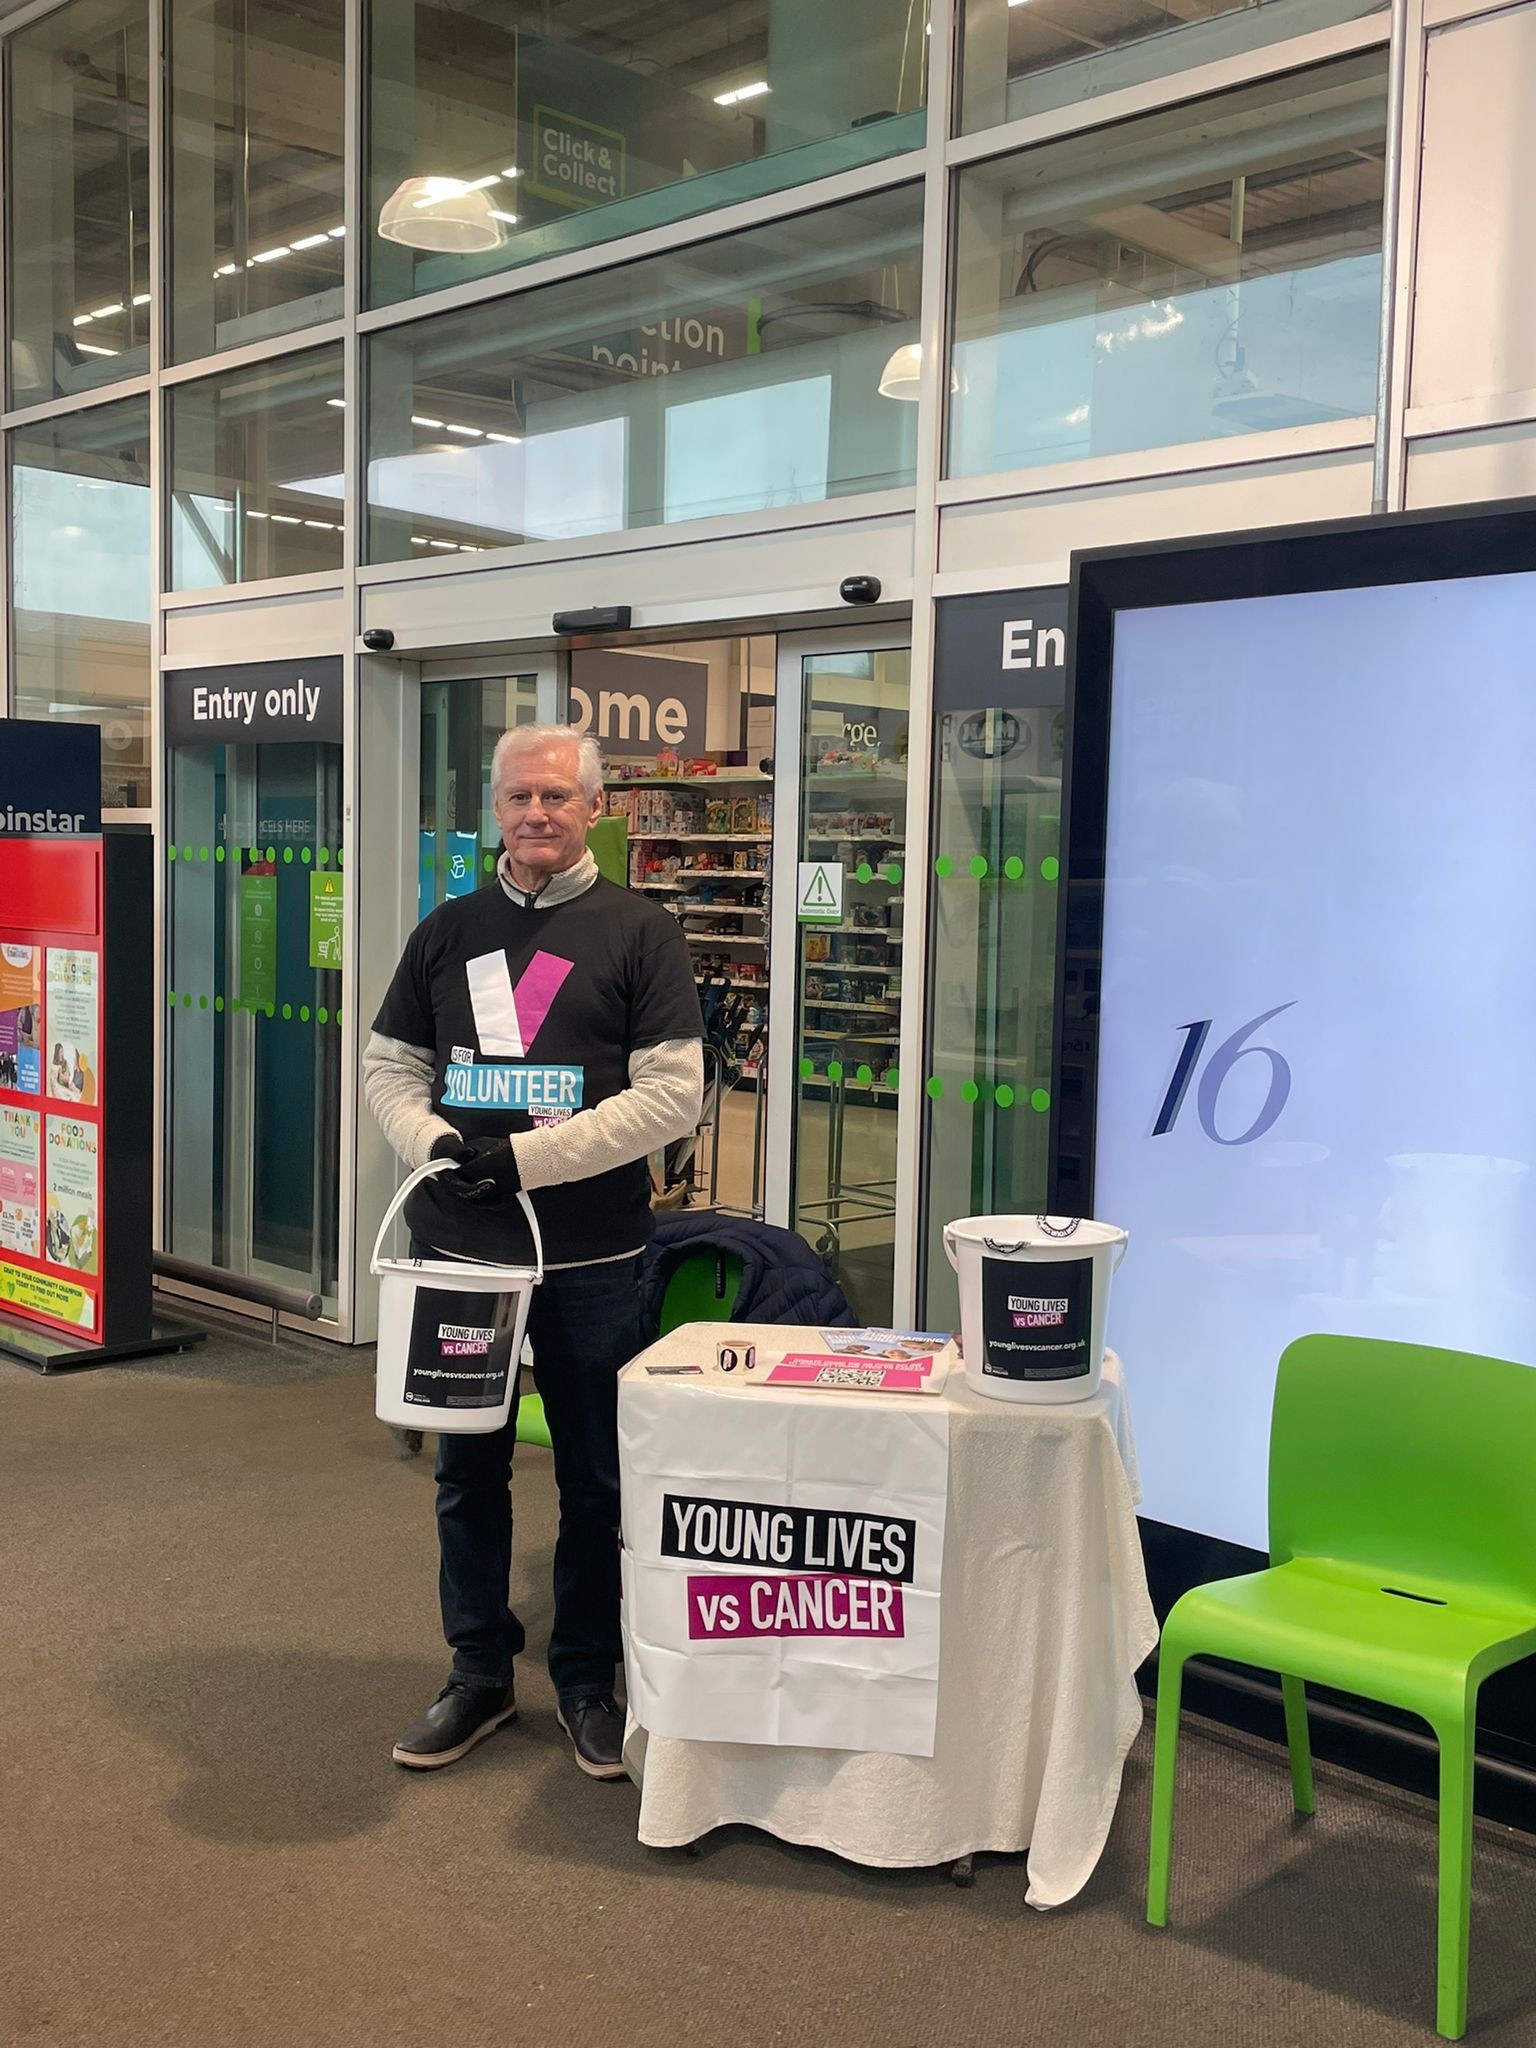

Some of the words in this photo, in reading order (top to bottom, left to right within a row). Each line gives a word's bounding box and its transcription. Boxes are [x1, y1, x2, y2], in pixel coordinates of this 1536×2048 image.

[543, 128, 595, 165] Click
[543, 154, 616, 196] Collect
[1001, 618, 1065, 670] En
[193, 687, 257, 725] Entry
[265, 679, 321, 722] only
[285, 820, 310, 833] HERE
[458, 1050, 472, 1064] FOR
[1151, 1000, 1299, 1146] 16
[448, 1069, 577, 1103] VOLUNTEER
[4, 1110, 31, 1127] THANK
[531, 1106, 552, 1115] YOUNG
[553, 1108, 570, 1116] LIVES
[11, 1125, 26, 1139] YOU
[61, 1122, 84, 1136] FOOD
[49, 1133, 97, 1154] DONATIONS
[53, 1183, 57, 1192] 2
[58, 1184, 76, 1196] million
[77, 1189, 93, 1200] meals
[1010, 1298, 1040, 1311] YOUNG
[1041, 1300, 1066, 1312] LIVES
[1014, 1317, 1026, 1327] vs
[1027, 1314, 1062, 1327] CANCER
[441, 1326, 470, 1340] YOUNG
[470, 1329, 493, 1341] LIVES
[443, 1346, 454, 1354] vs
[455, 1343, 488, 1354] CANCER
[988, 1340, 1086, 1352] younglivesvscancer.org.uk
[413, 1368, 505, 1380] younglivesvscancer.org.uk
[671, 1502, 794, 1563] YOUNG
[804, 1515, 907, 1575] LIVES
[697, 1594, 740, 1631] vs
[750, 1578, 896, 1631] CANCER
